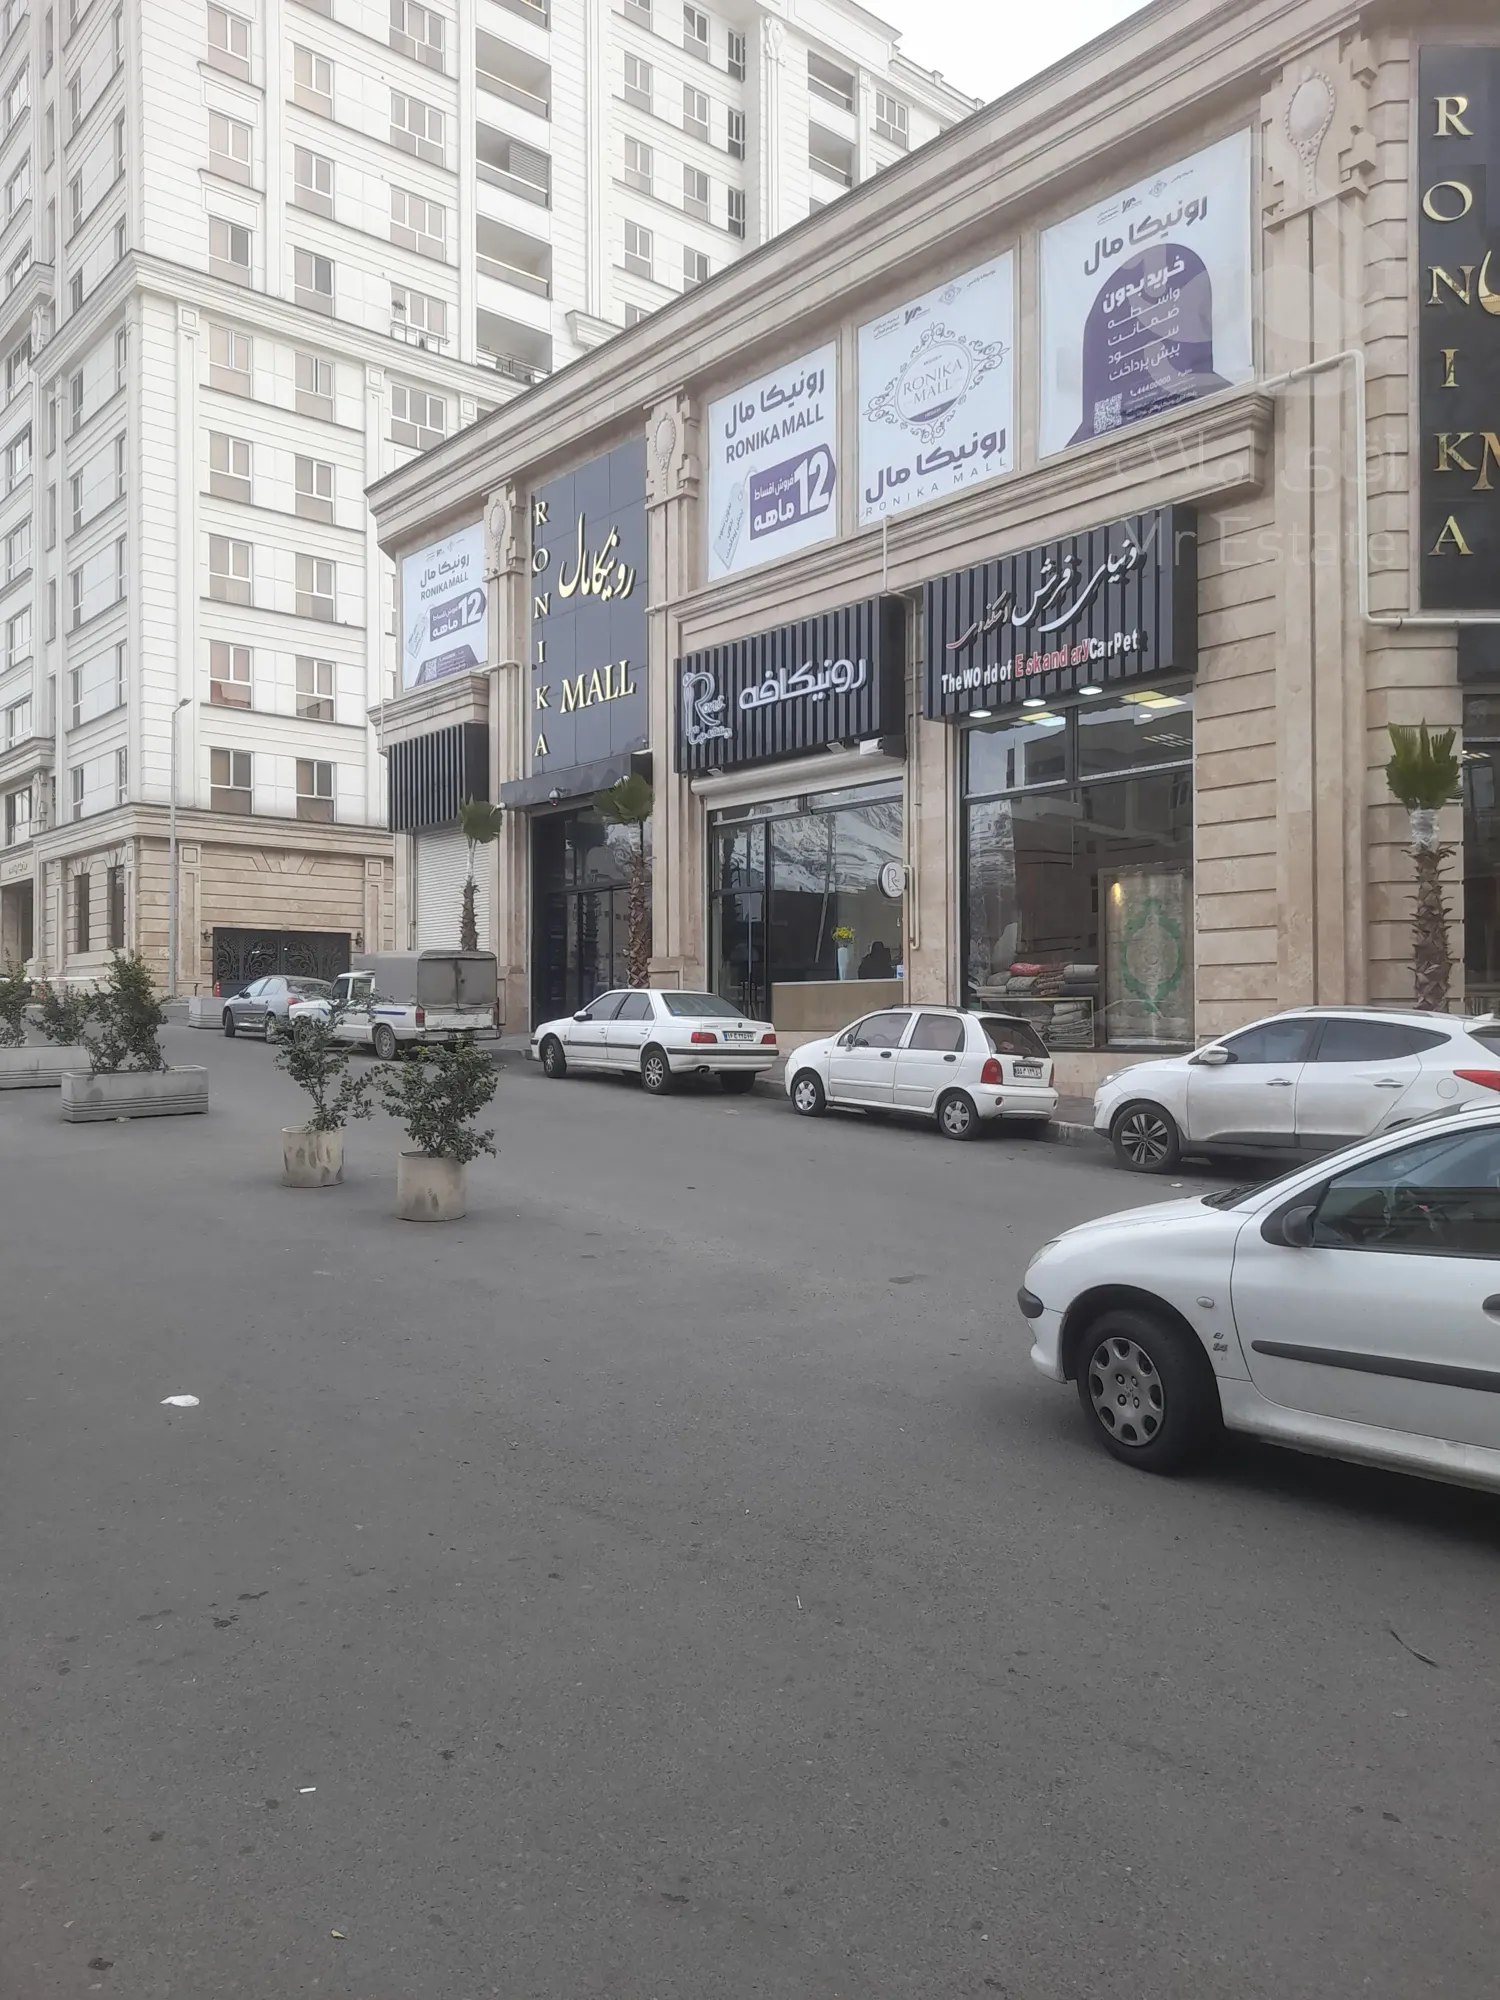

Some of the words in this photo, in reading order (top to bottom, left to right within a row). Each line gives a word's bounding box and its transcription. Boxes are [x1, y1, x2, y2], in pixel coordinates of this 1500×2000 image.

[1129, 196, 1208, 246] رونیکا
[1084, 236, 1124, 276] مال
[1147, 255, 1185, 289] خرید
[1103, 277, 1145, 314] بدون
[1422, 96, 1474, 556] RONIKA
[1109, 357, 1149, 381] پرداخت
[1151, 342, 1180, 367] پیش
[760, 368, 825, 413] رونیکا
[903, 358, 963, 396] RONIKA
[913, 378, 953, 405] MALL
[725, 400, 755, 439] مال
[726, 423, 780, 464] RONIKA
[782, 403, 824, 438] MALL
[916, 428, 1006, 476] رونیکا
[754, 481, 775, 501] اقساط
[774, 474, 794, 496] فروش
[793, 450, 830, 516] 12
[865, 466, 911, 504] مال
[865, 482, 939, 517] RONIKA
[953, 457, 1006, 485] MALL
[753, 498, 795, 532] ماهه
[420, 564, 437, 589] مال
[438, 553, 470, 576] رونیکا
[420, 579, 449, 601] RONIKA
[448, 571, 469, 589] MALL
[1011, 555, 1075, 626] فرش
[1037, 539, 1138, 632] دنیای
[432, 617, 459, 638] ماهه
[458, 591, 482, 626] 12
[532, 500, 550, 757] RONIKA
[560, 659, 637, 714] MALL
[941, 673, 962, 694] The
[1000, 659, 1012, 681] of
